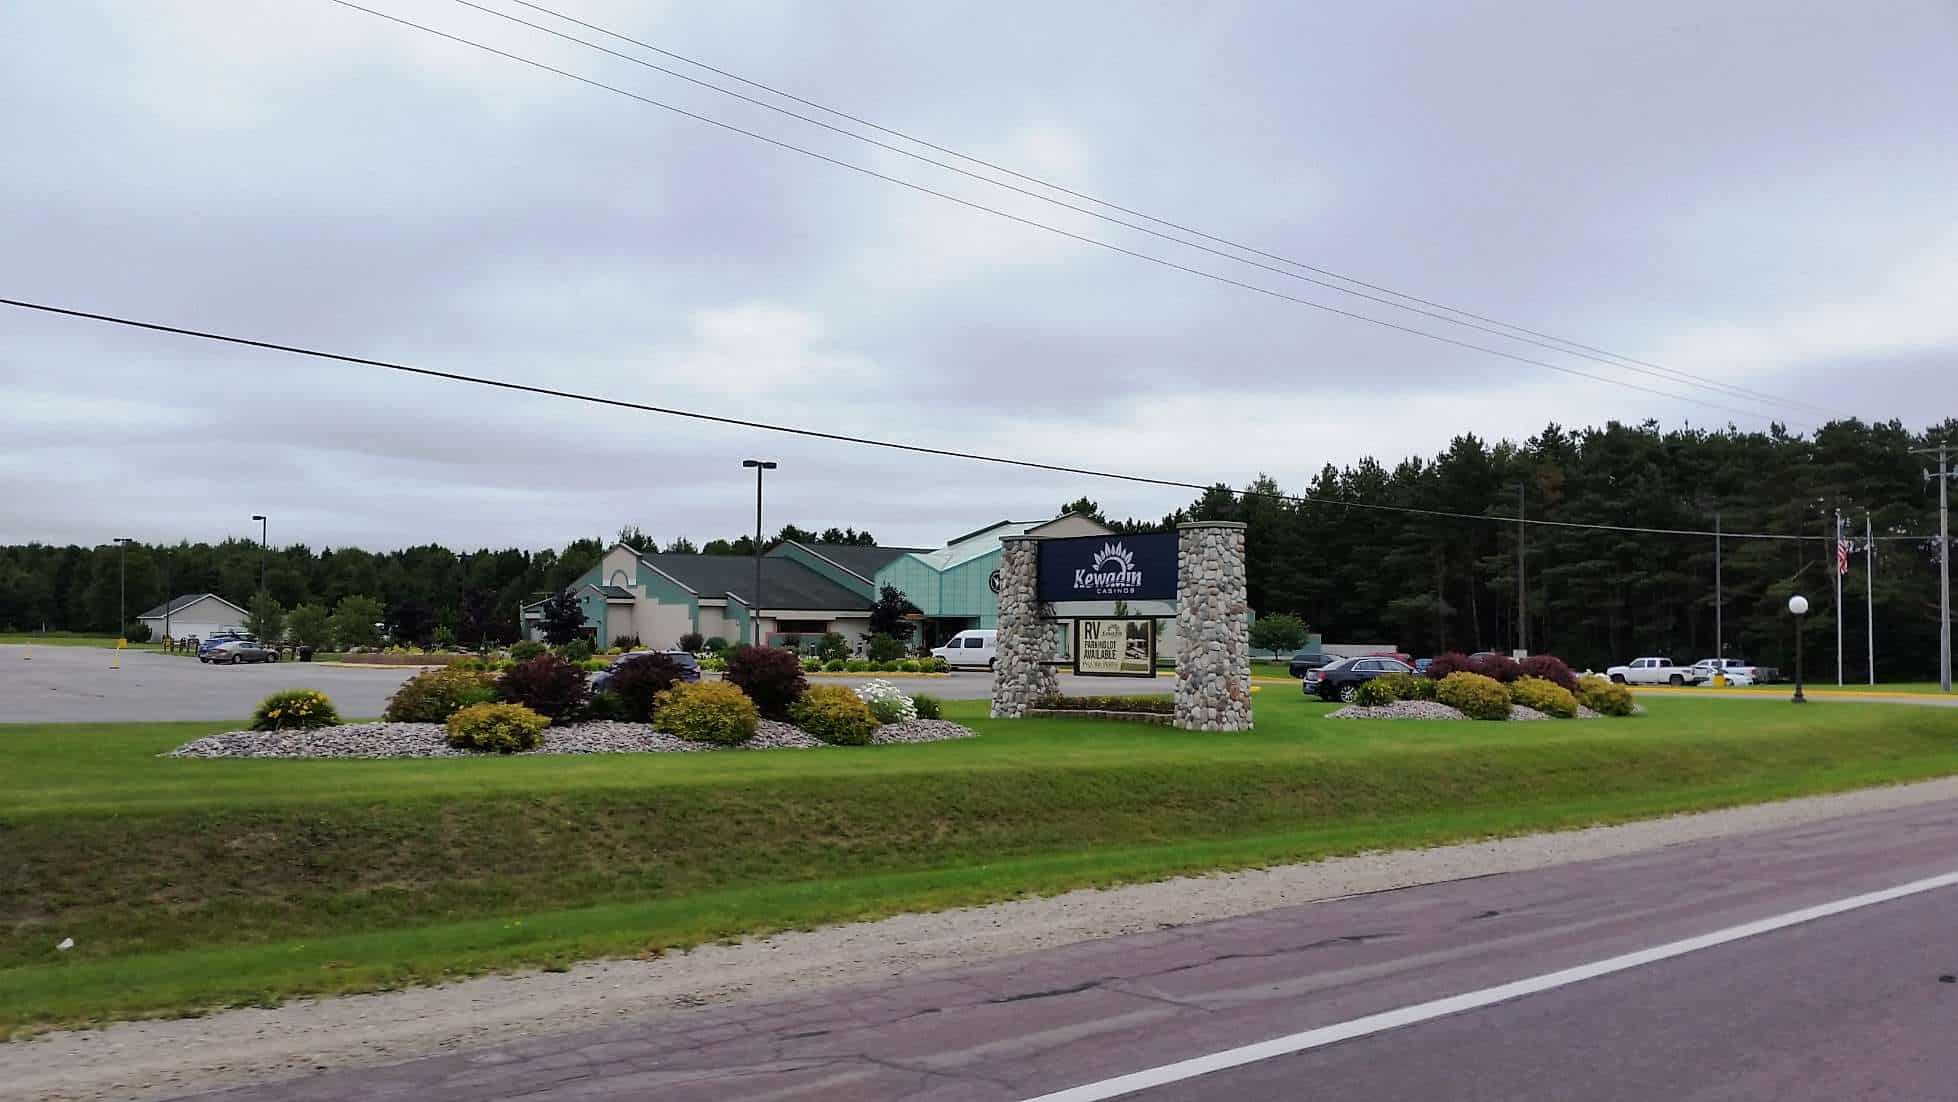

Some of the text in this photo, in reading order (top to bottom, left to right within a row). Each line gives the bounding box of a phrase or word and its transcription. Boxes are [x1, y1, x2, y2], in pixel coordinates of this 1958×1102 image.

[1073, 568, 1142, 588] Kewadin
[1085, 621, 1101, 639] RV
[1107, 640, 1116, 649] LOT
[1084, 649, 1116, 660] AVAILABLE
